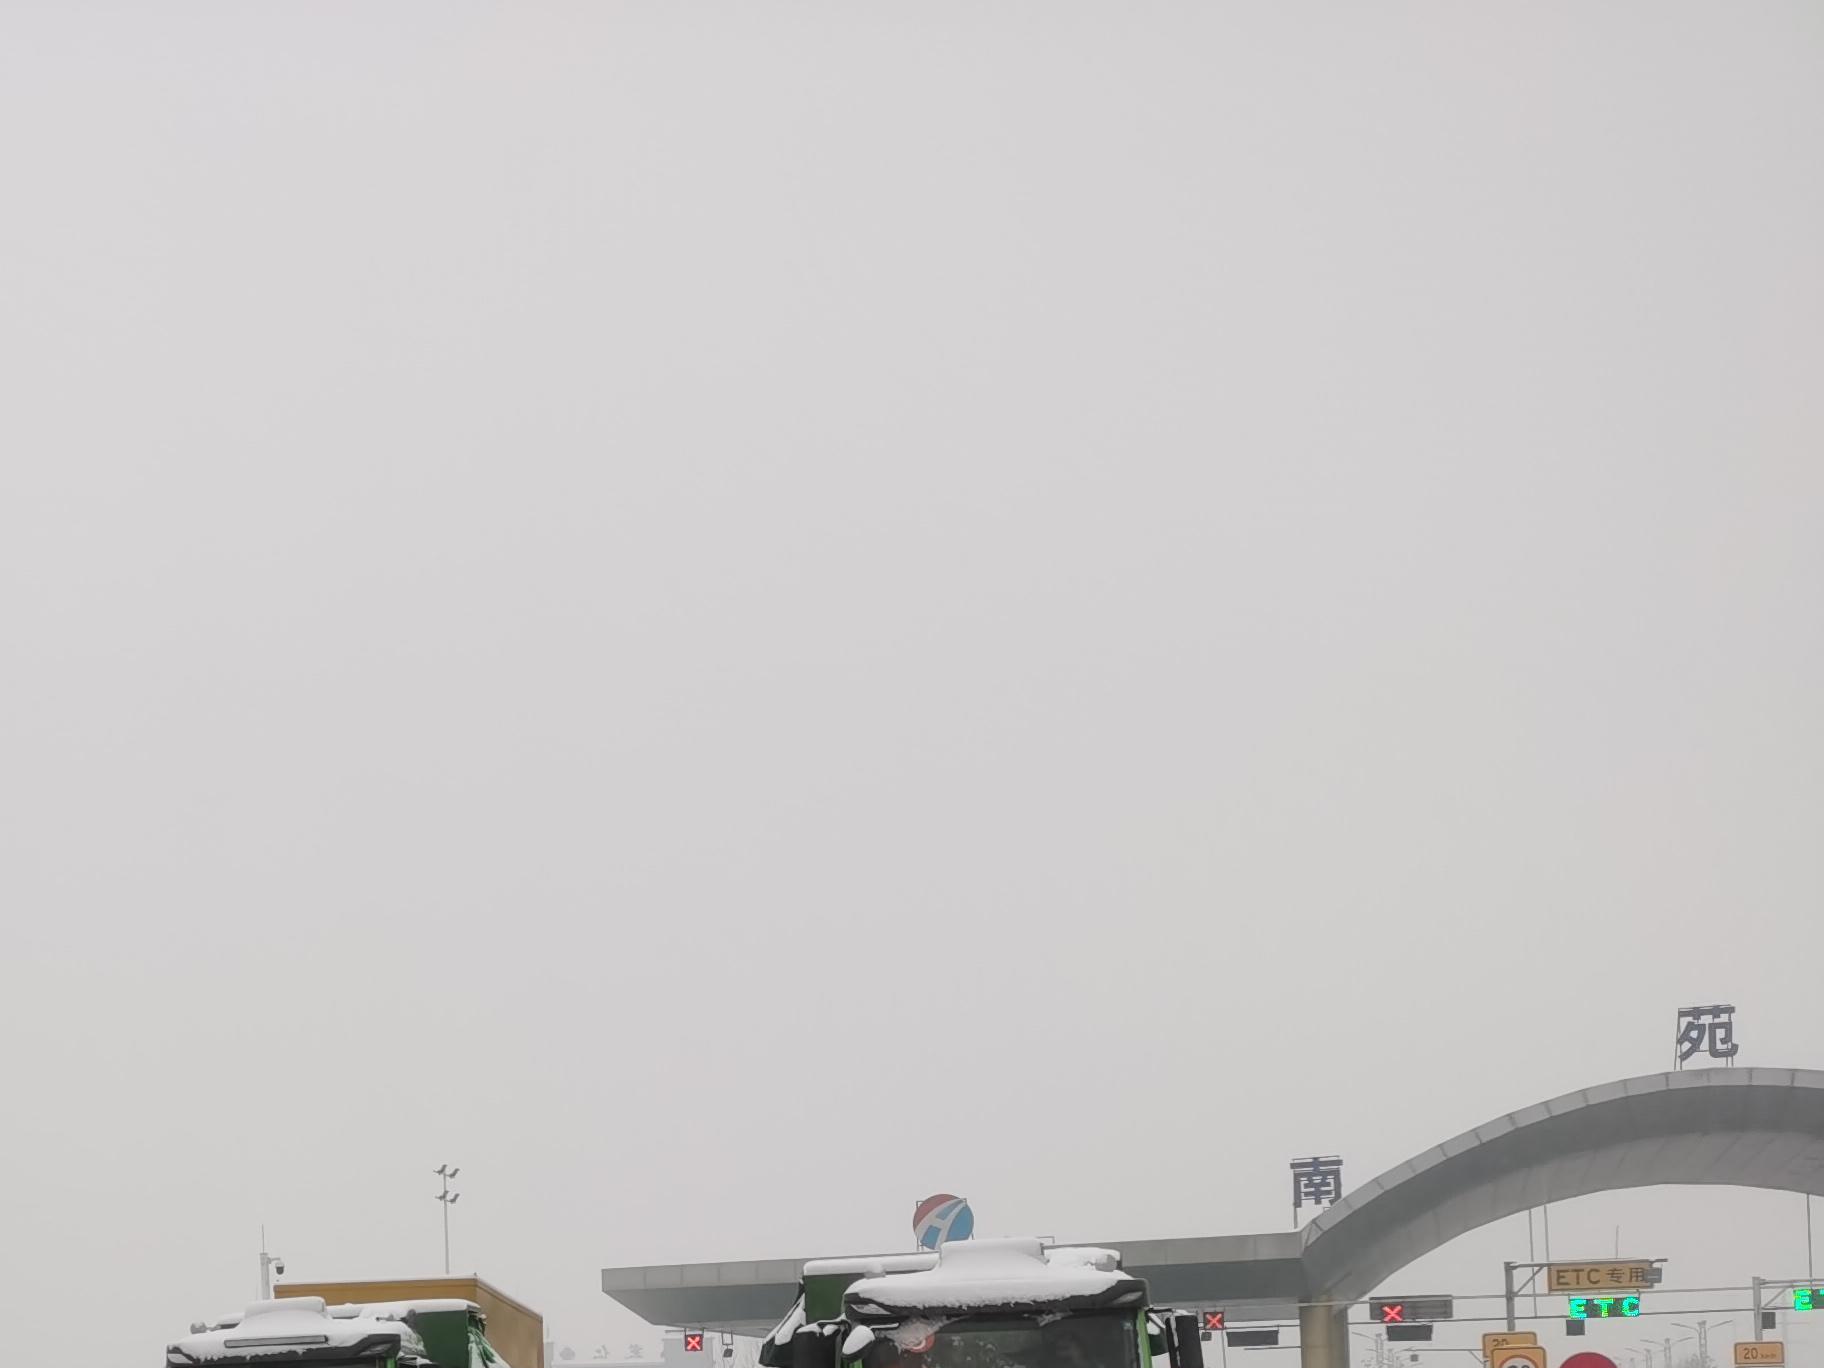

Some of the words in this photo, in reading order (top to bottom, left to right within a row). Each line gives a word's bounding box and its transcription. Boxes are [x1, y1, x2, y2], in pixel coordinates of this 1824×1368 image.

[1677, 1006, 1738, 1061] 苑
[1290, 1157, 1342, 1208] 南
[1556, 1268, 1601, 1285] ETC
[1606, 1267, 1645, 1284] 专用
[1569, 1296, 1640, 1319] ETC
[1744, 1347, 1759, 1360] 20
